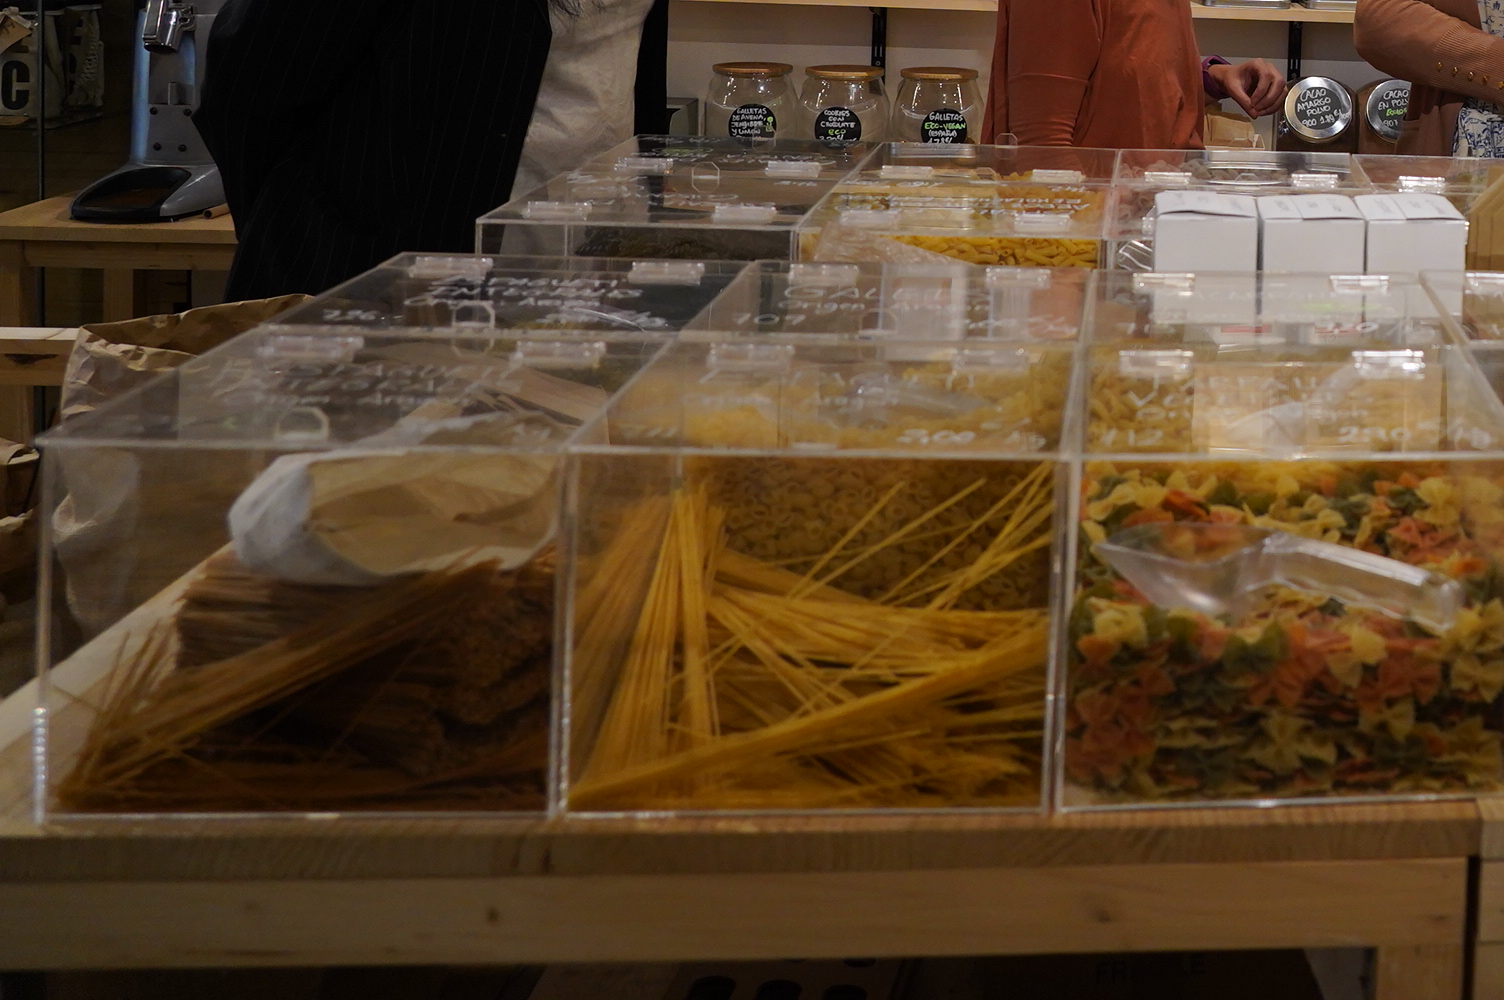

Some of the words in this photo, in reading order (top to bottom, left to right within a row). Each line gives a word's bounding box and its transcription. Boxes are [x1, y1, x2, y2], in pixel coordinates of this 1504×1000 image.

[1299, 88, 1327, 102] CACAO
[1383, 88, 1409, 100] CACAO
[1297, 97, 1332, 112] AMARGO
[1378, 101, 1389, 111] EN
[1391, 99, 1409, 108] POLV
[736, 107, 767, 115] GALLETAS
[929, 112, 963, 121] GALLETAS
[1306, 105, 1331, 117] POLVO
[924, 121, 967, 131] ECO-VEGAN
